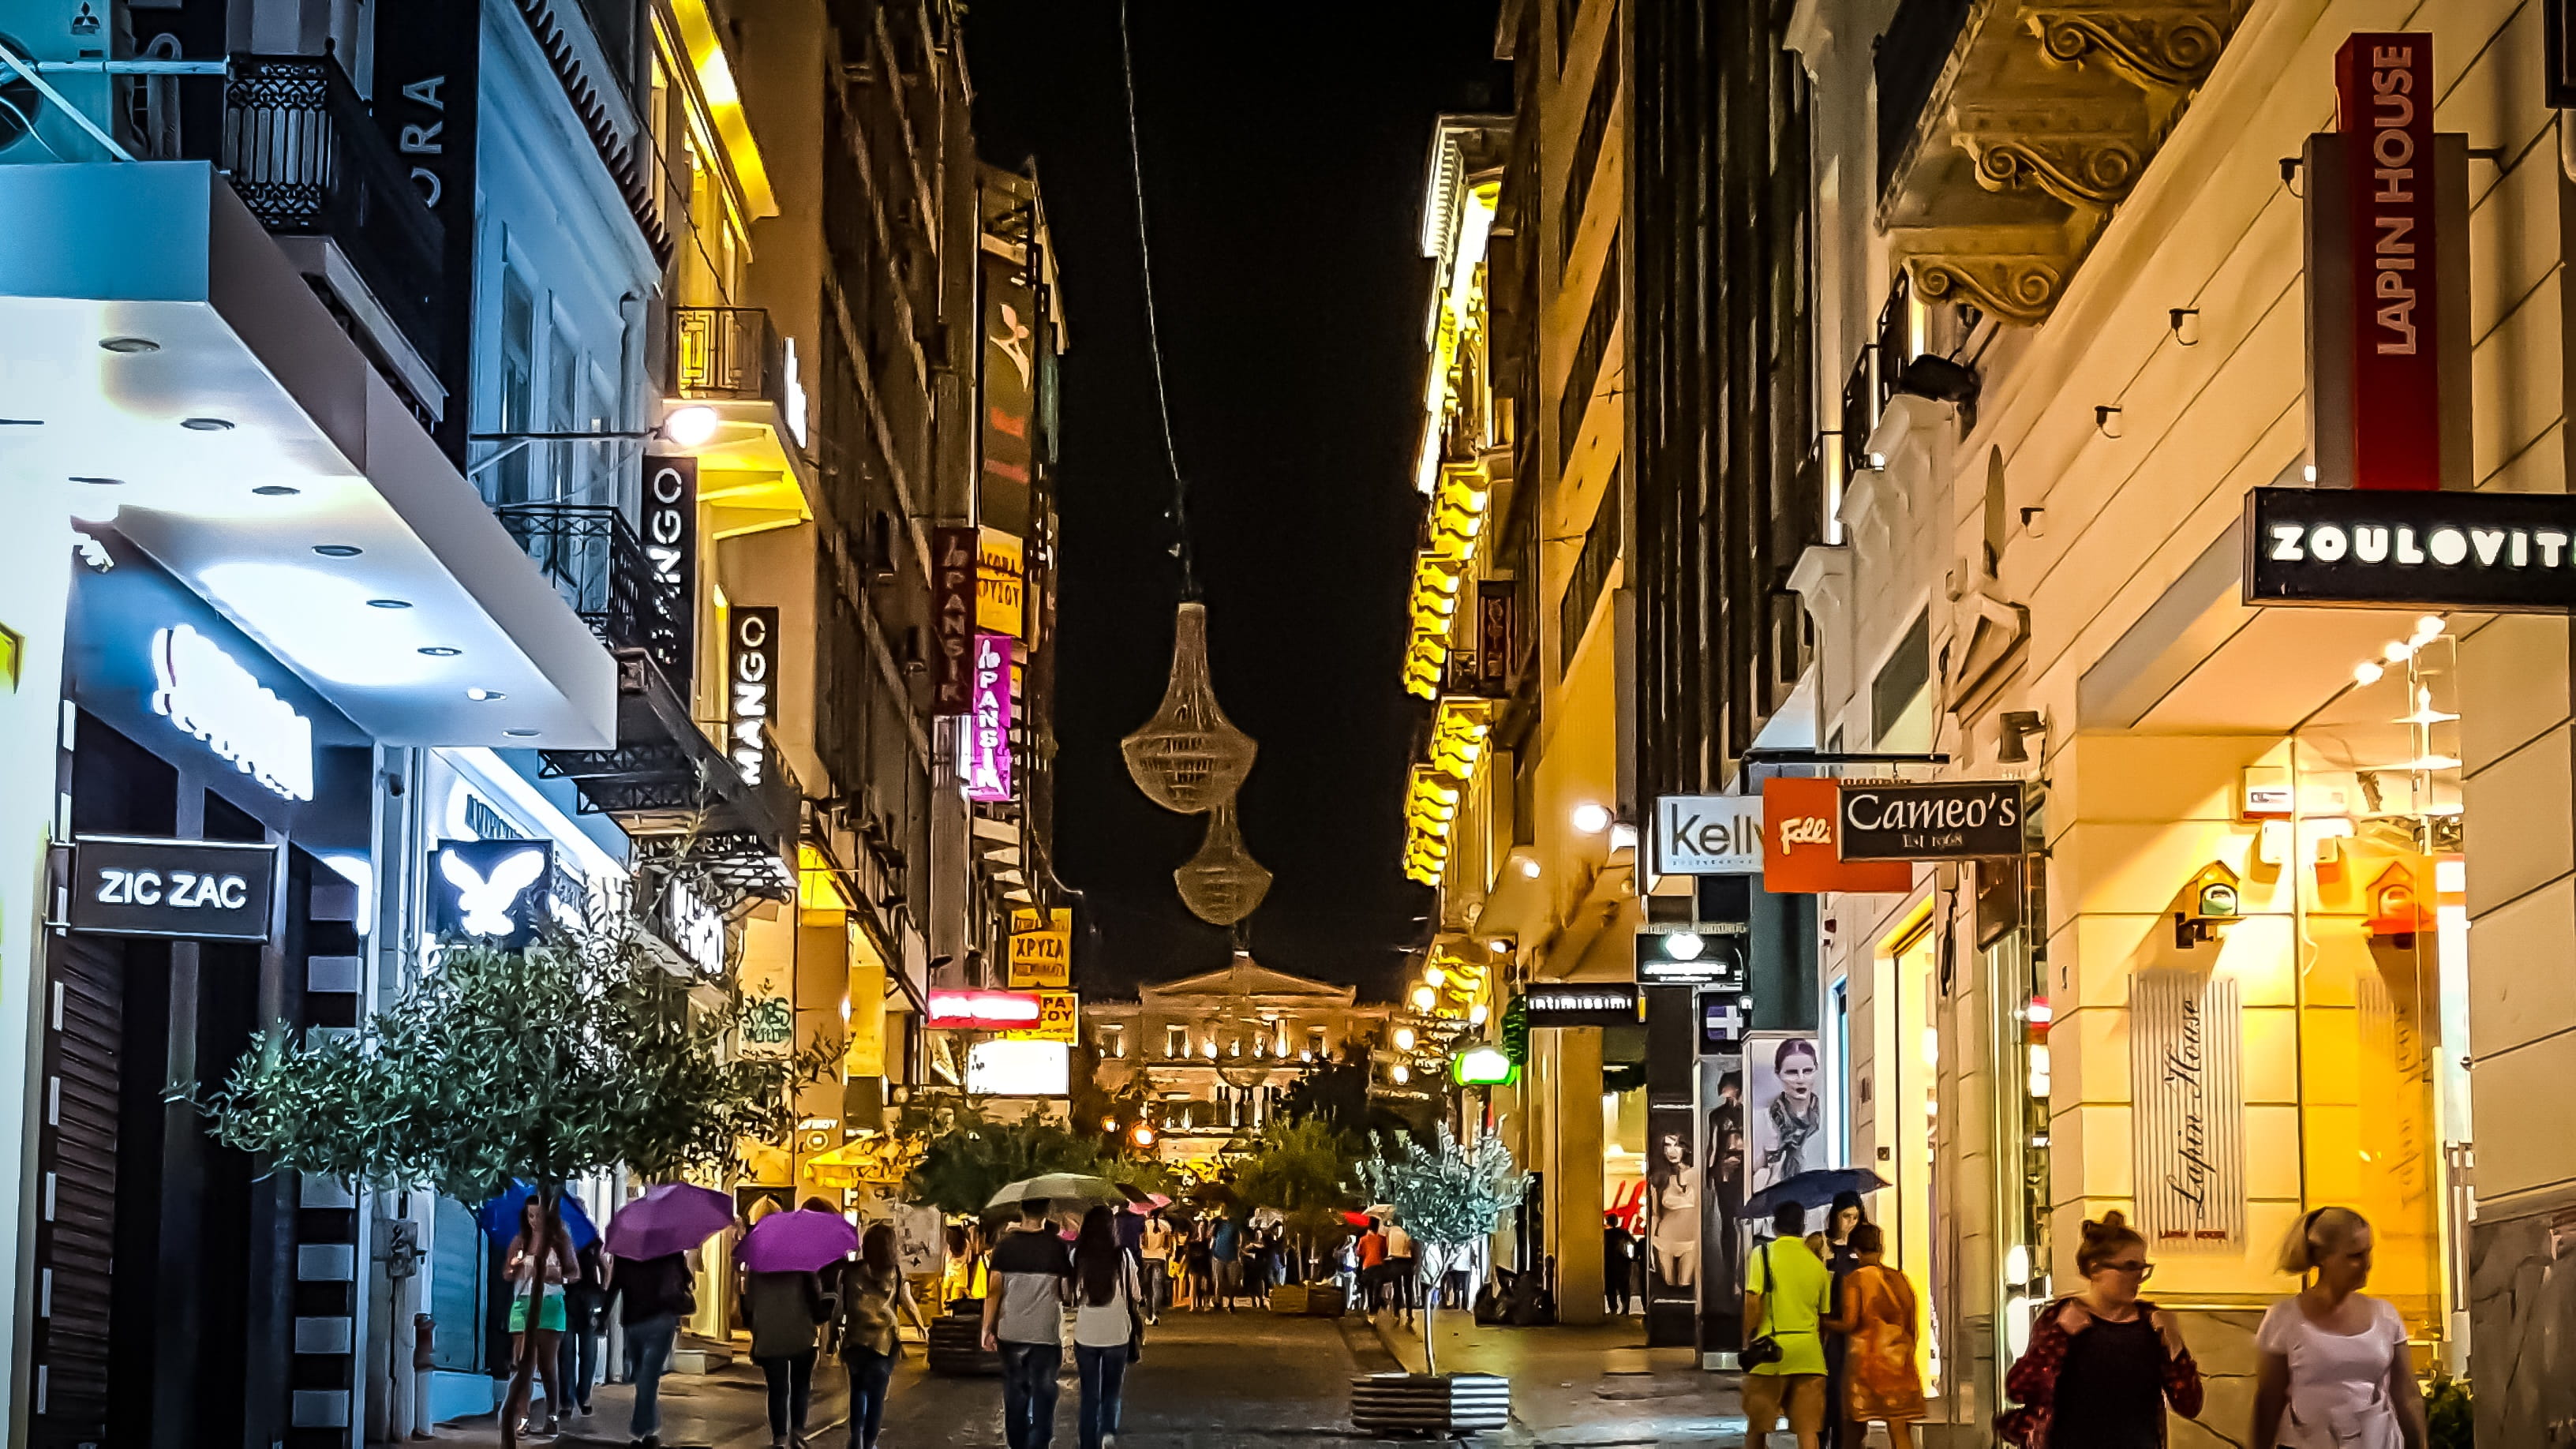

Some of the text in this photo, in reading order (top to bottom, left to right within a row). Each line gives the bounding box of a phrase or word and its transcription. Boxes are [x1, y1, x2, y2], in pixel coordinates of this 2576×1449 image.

[2373, 46, 2416, 354] LAPIN HOUSE
[646, 467, 682, 665] NGO
[2271, 525, 2576, 567] ZOULOVIT
[733, 616, 766, 786] MANGO
[1848, 792, 2016, 830] Cameo's
[1780, 816, 1833, 856] Folli
[96, 869, 247, 909] ZIC ZAC
